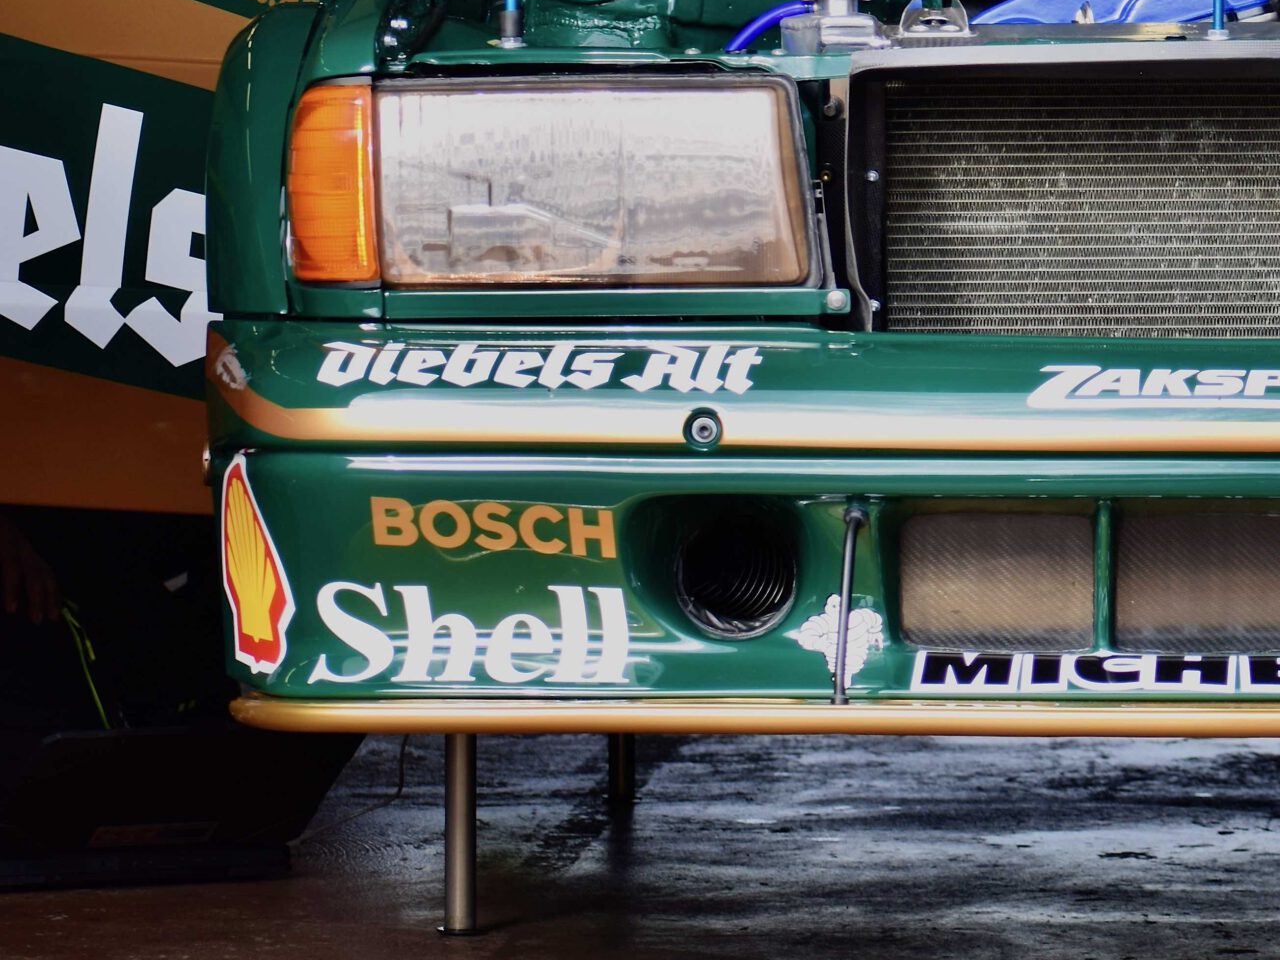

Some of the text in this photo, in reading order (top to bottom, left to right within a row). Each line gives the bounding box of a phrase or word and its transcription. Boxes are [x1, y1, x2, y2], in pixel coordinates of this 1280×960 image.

[316, 341, 763, 395] Diebels Alt
[369, 495, 618, 560] BOSCH
[306, 581, 631, 685] Shell
